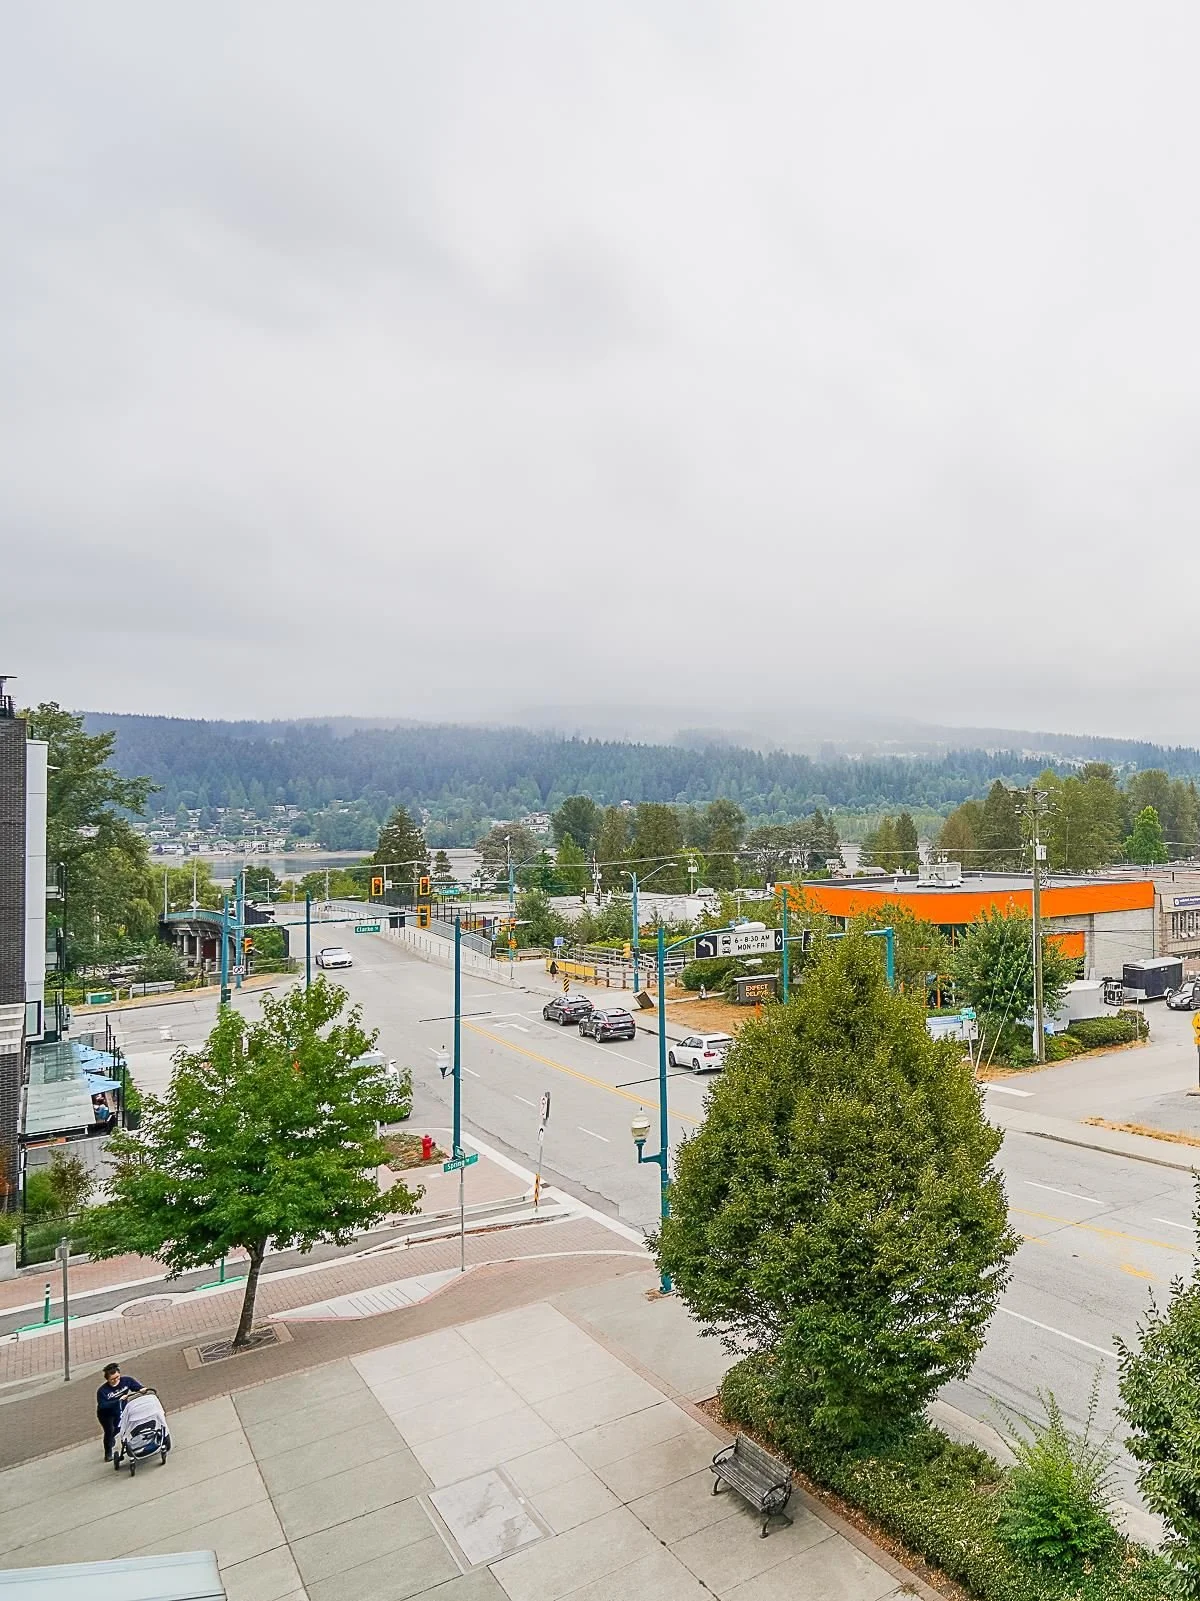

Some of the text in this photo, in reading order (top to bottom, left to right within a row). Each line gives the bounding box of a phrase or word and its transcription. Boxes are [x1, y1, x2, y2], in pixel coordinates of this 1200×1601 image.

[744, 935, 759, 943] 8:30
[745, 983, 769, 991] EXPECT
[447, 1159, 465, 1171] Spring
